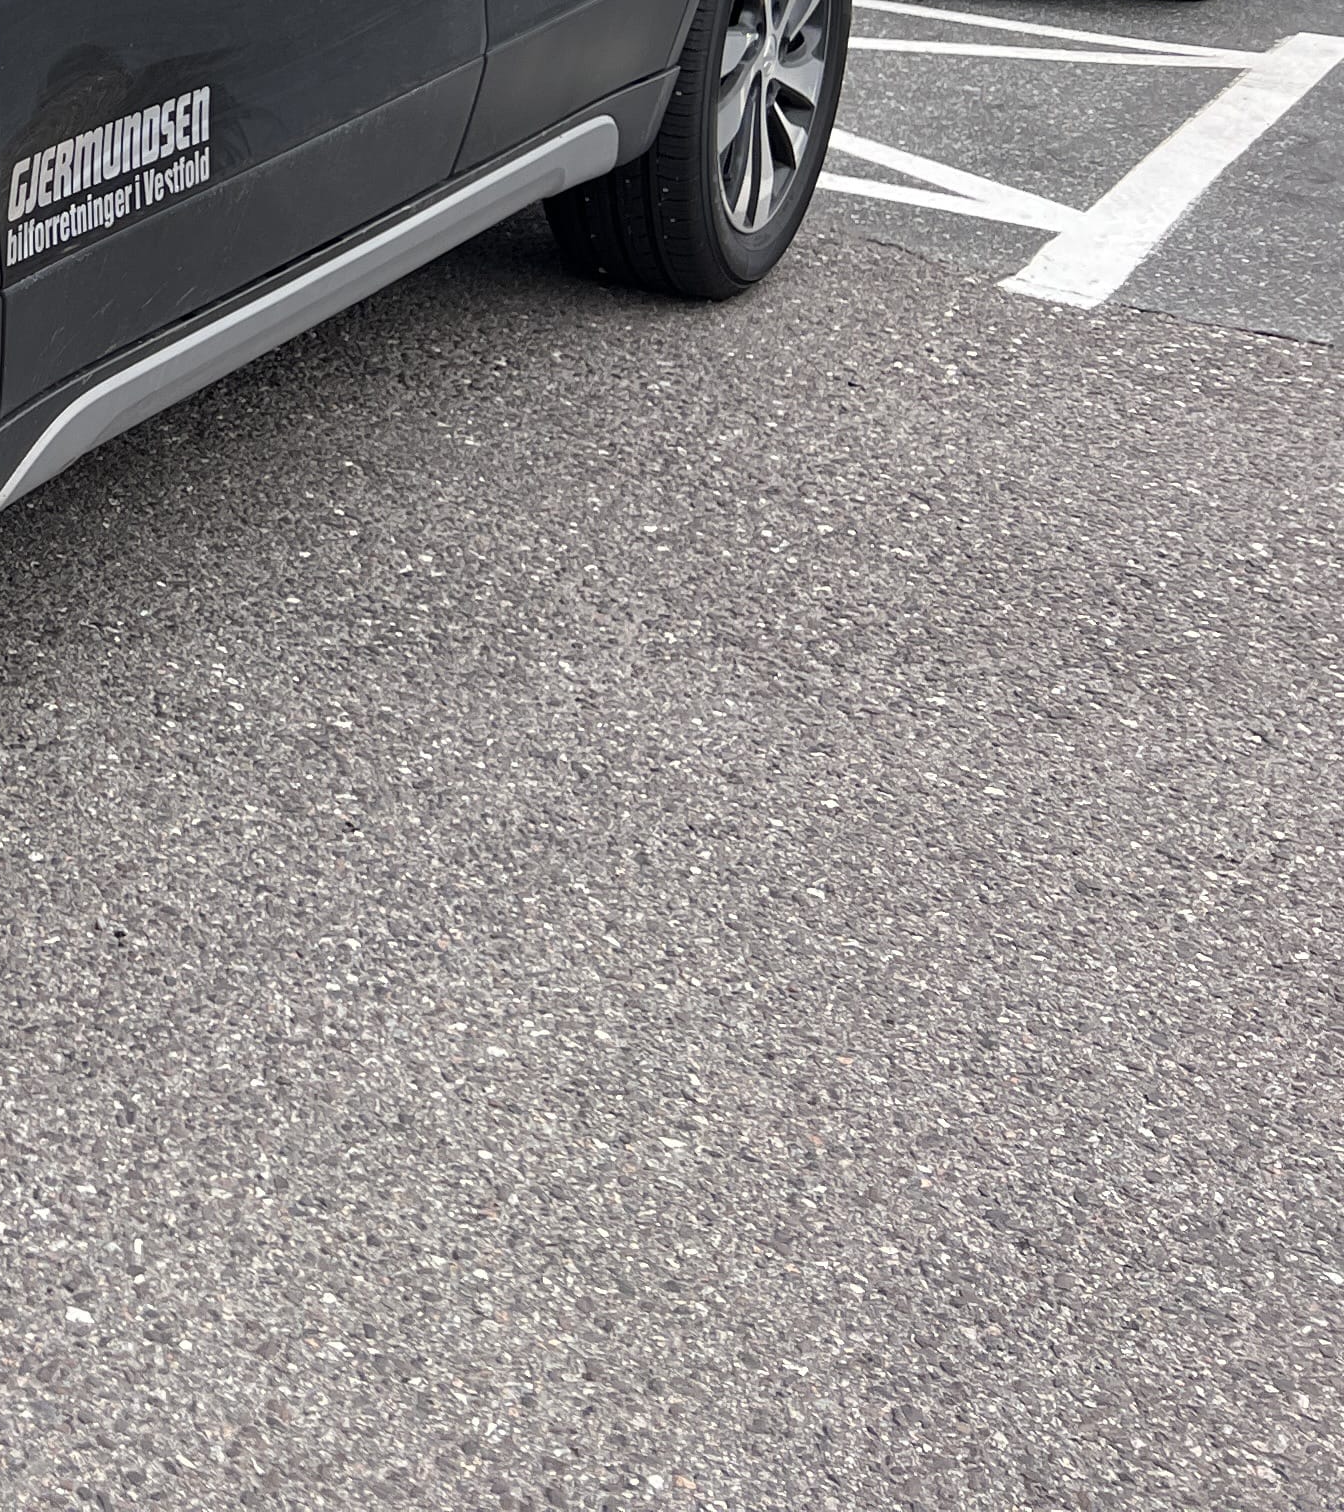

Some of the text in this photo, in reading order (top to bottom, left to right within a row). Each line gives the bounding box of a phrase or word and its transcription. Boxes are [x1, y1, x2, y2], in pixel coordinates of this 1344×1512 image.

[6, 146, 210, 268] bilforretninger i Vestfold
[7, 85, 211, 223] GJERMUNDSEN
